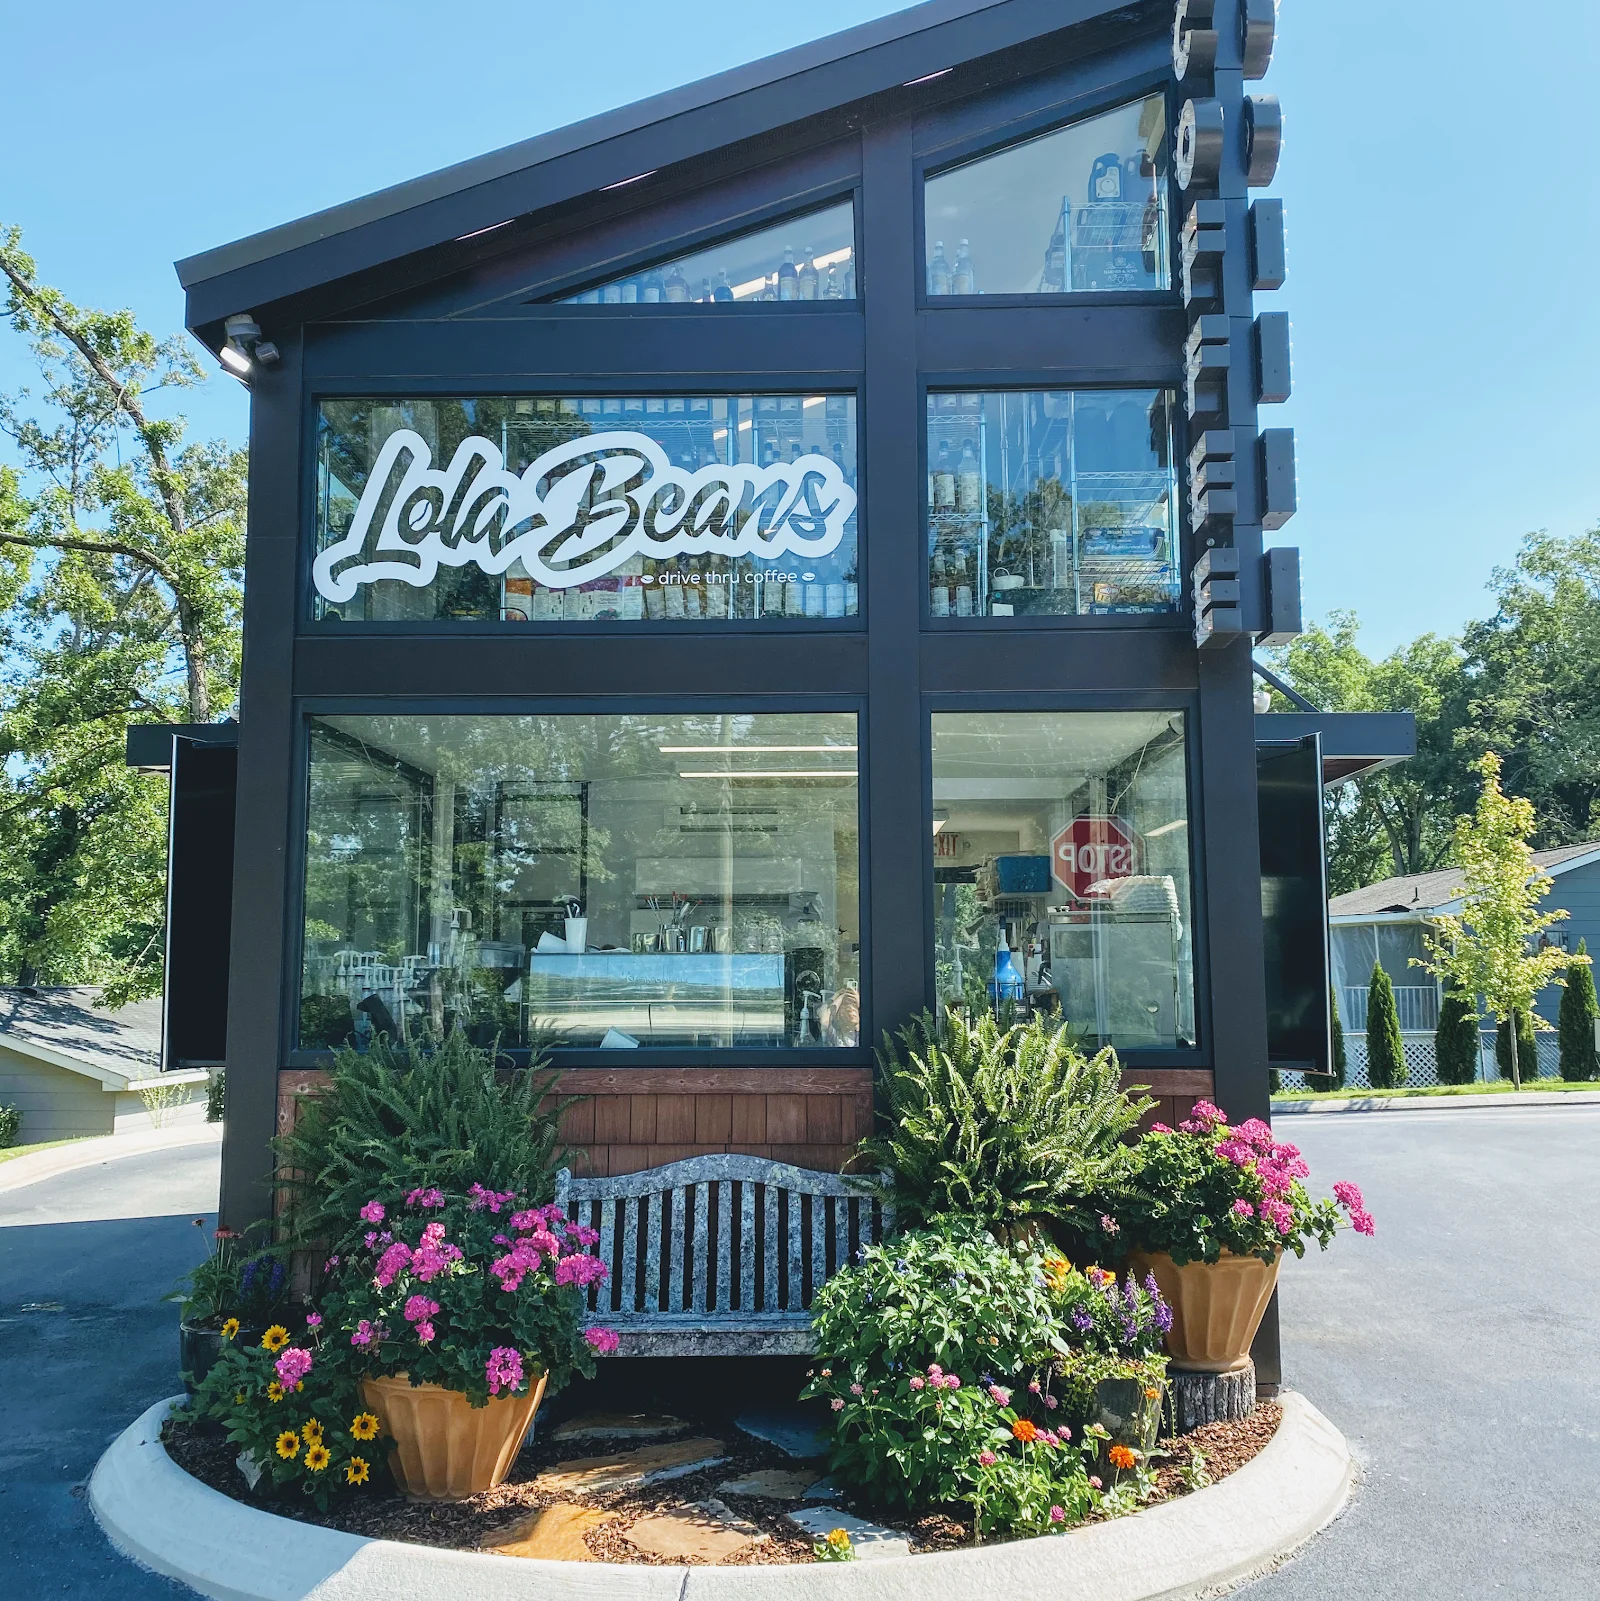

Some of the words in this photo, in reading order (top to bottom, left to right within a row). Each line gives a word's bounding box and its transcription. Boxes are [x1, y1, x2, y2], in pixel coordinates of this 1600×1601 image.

[313, 428, 526, 602] Lola
[522, 431, 857, 588] Beans
[658, 571, 701, 585] drive
[704, 570, 740, 584] thru
[744, 569, 798, 584] coffee
